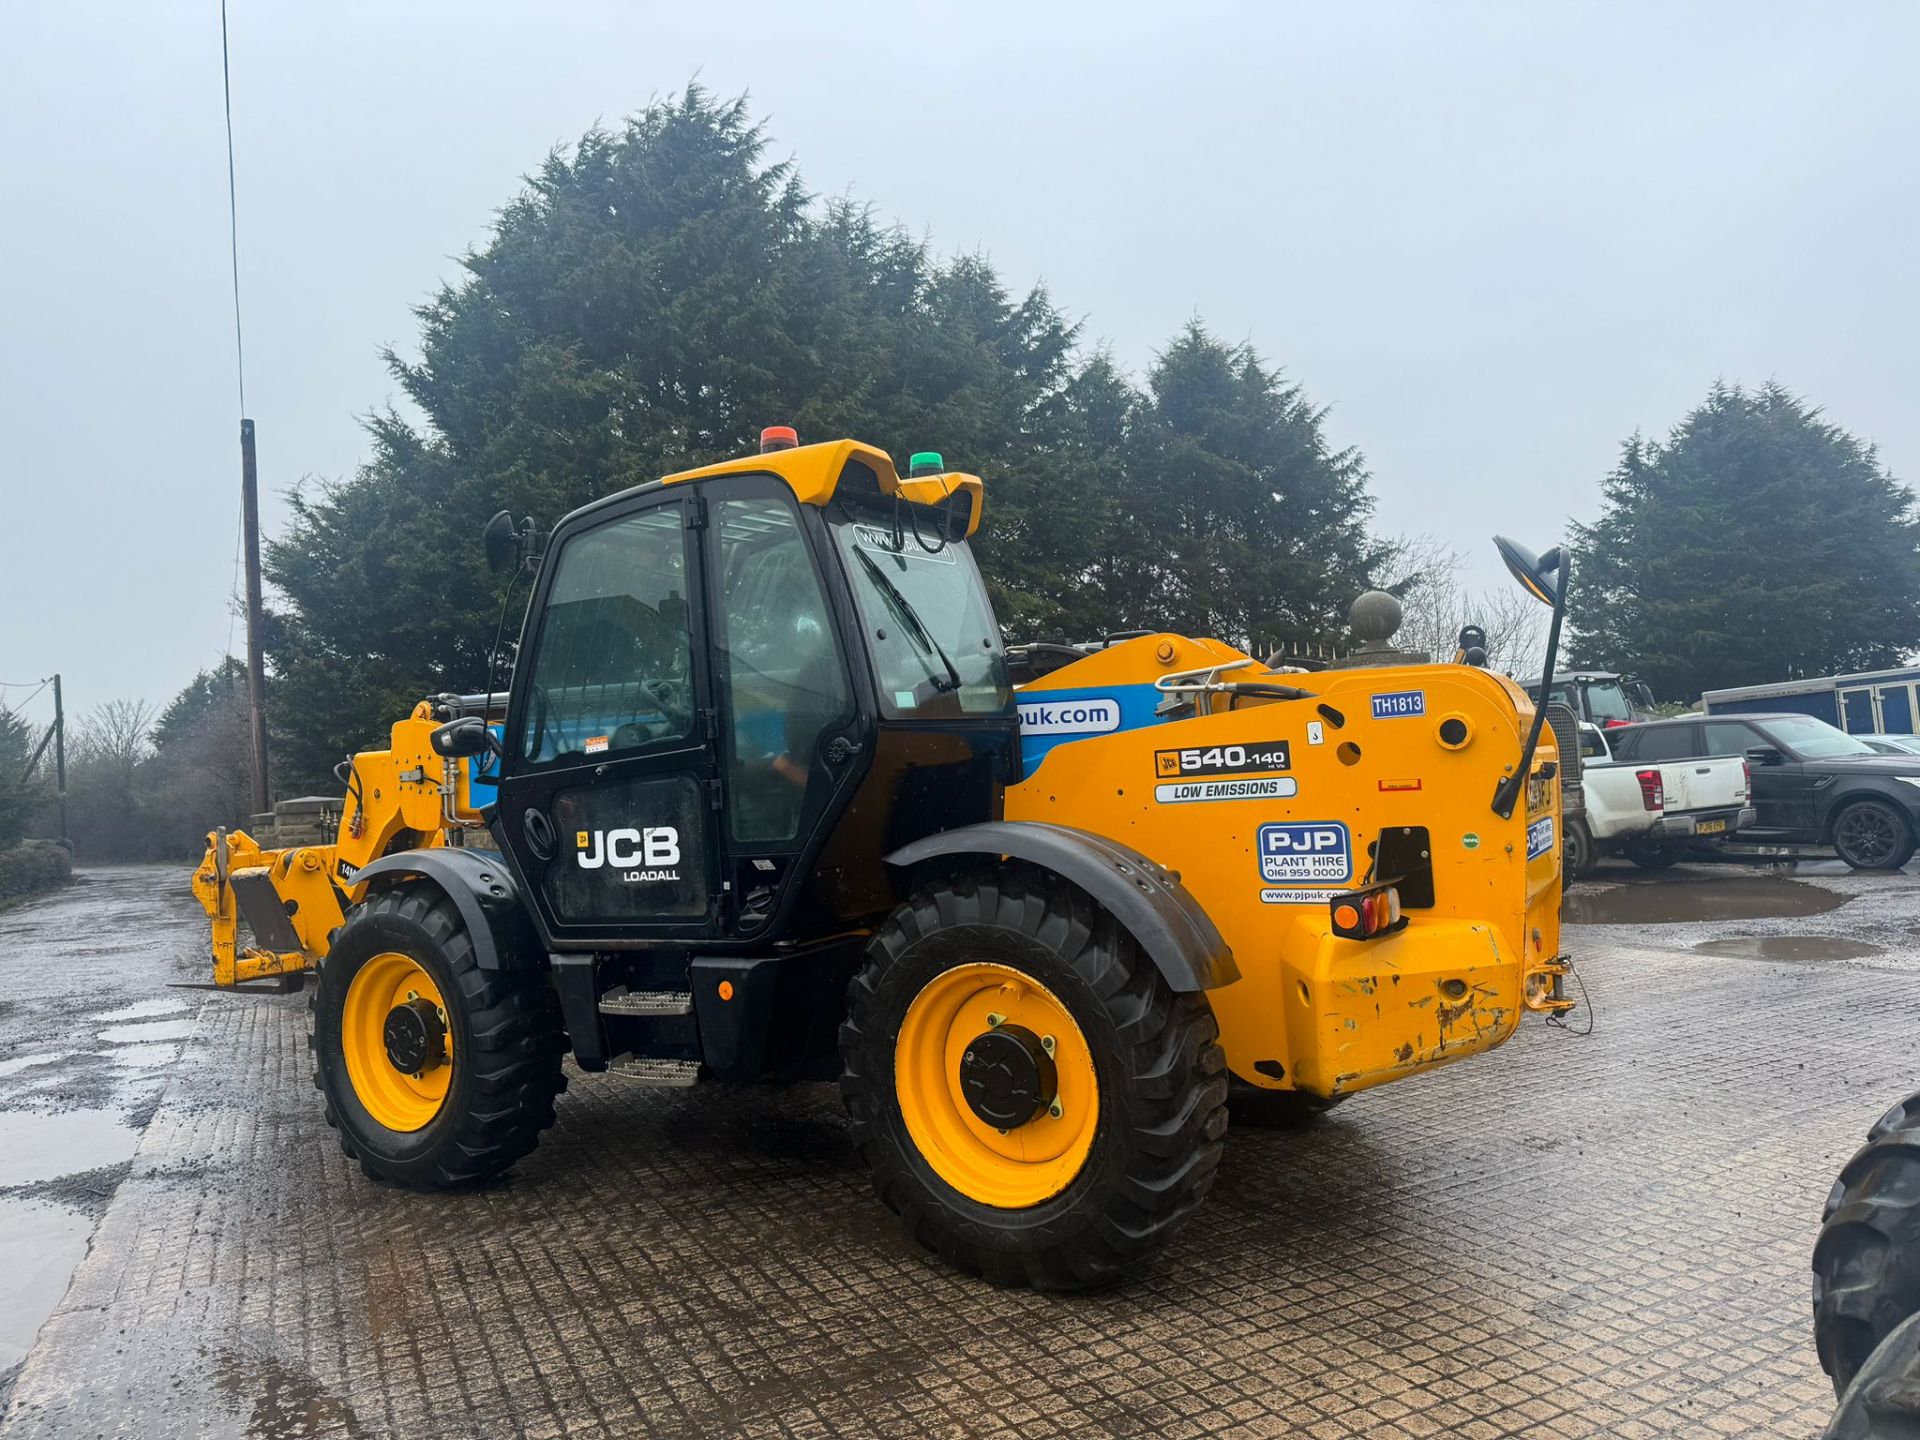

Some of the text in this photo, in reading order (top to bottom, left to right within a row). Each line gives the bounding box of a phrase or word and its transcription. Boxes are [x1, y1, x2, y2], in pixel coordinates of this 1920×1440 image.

[1372, 696, 1422, 714] TH1813
[1181, 746, 1285, 770] 540-140
[1174, 782, 1278, 799] LOW EMISSIONS
[577, 827, 680, 869] JCB
[1268, 831, 1337, 851] PJP
[1264, 856, 1344, 867] PLANT HIRE
[623, 870, 680, 882] LOADALL
[1267, 868, 1344, 877] 0161 959 0000
